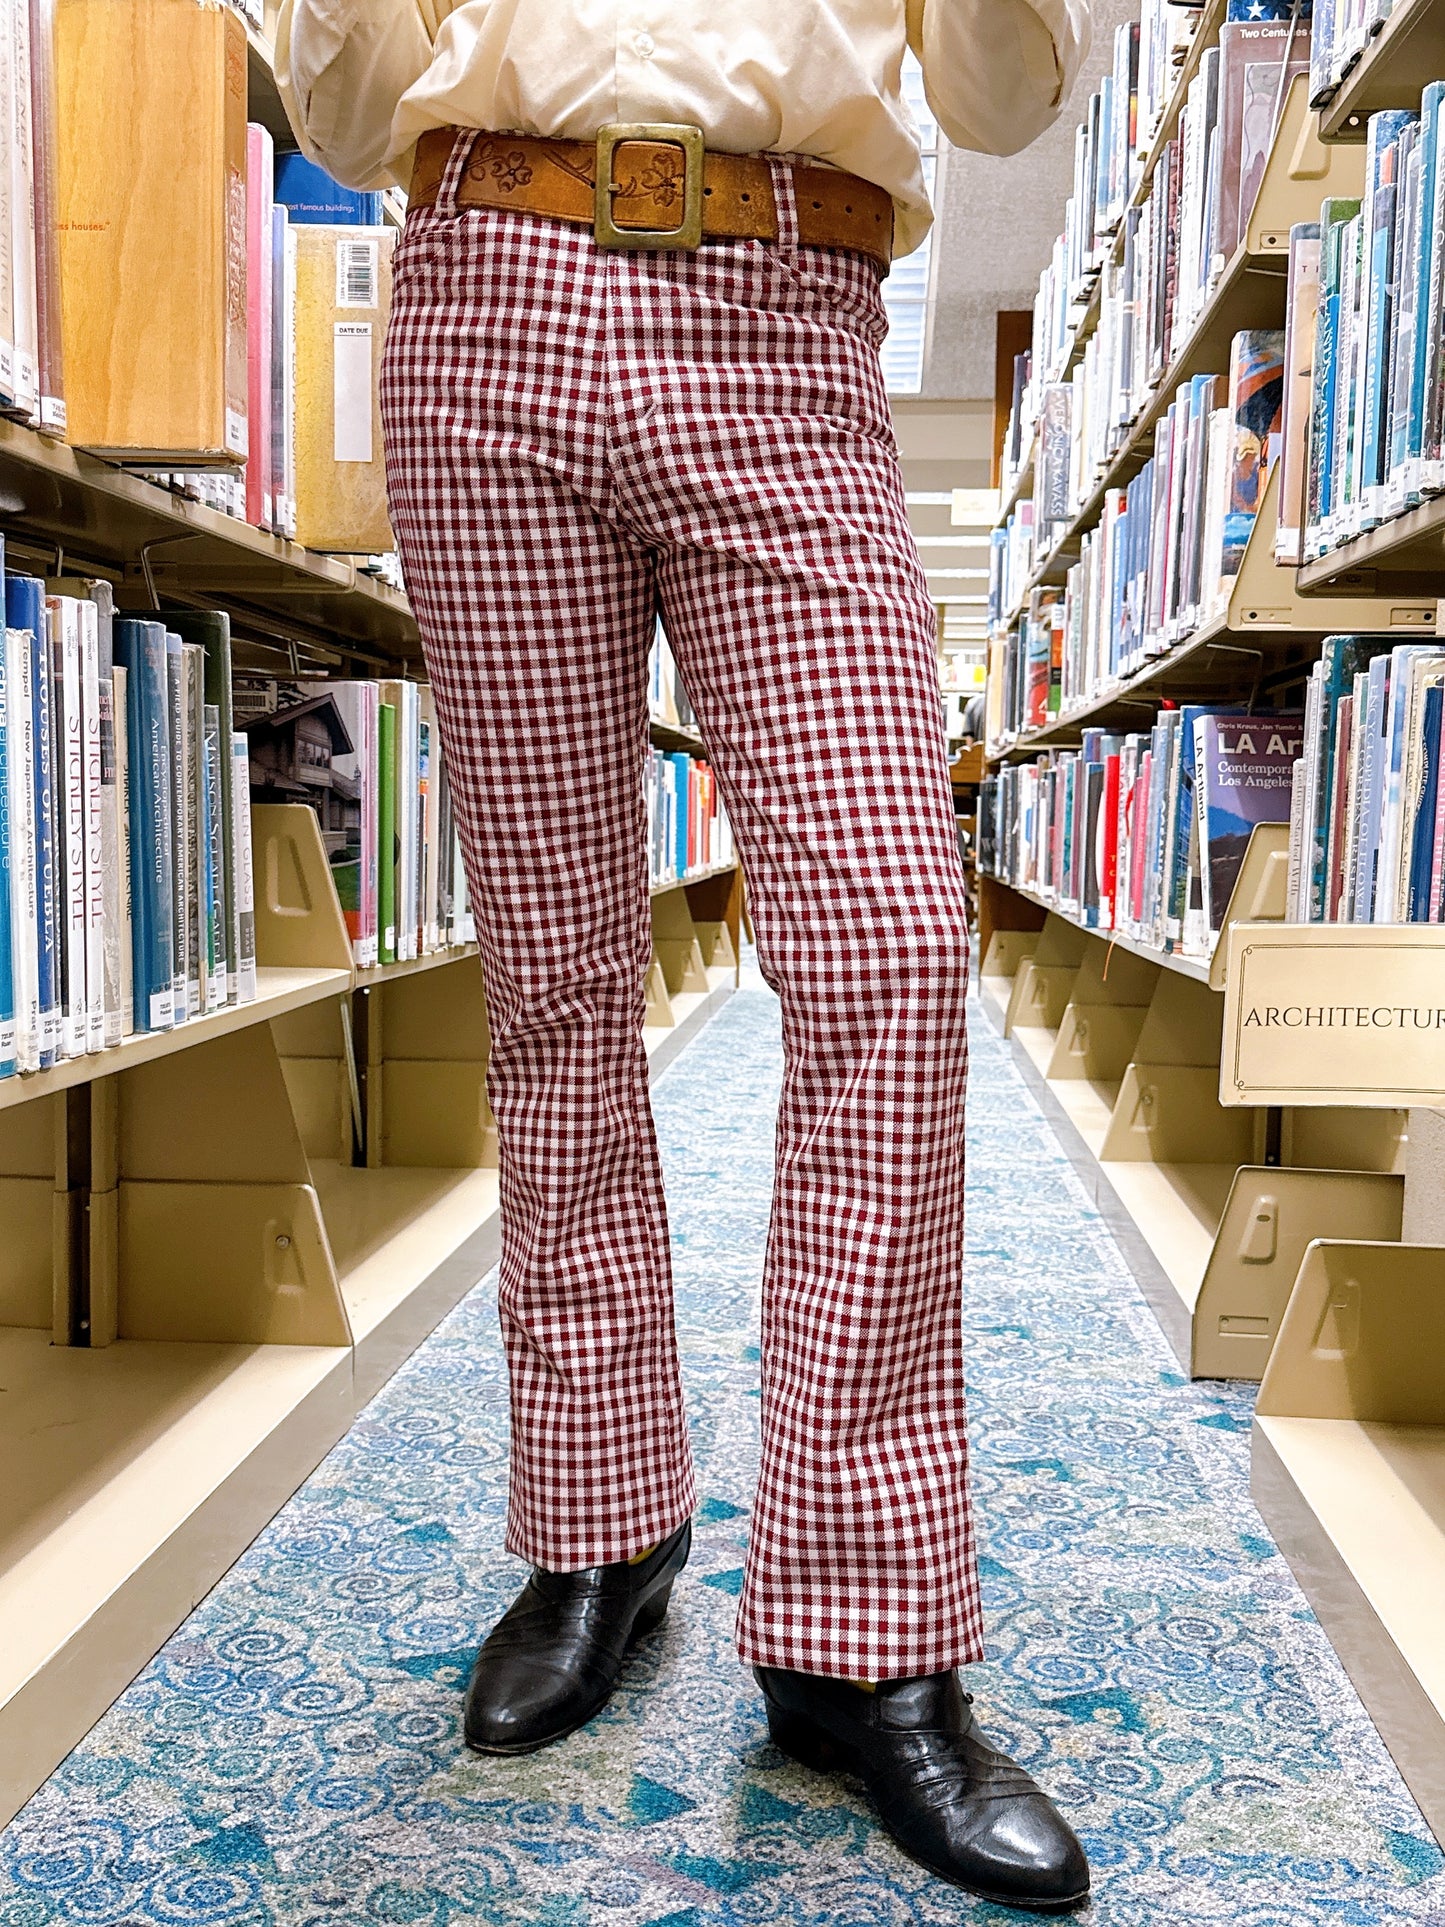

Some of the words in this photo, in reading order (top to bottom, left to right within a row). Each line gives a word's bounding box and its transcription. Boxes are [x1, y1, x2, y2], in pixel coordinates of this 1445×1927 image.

[1240, 29, 1259, 38] Two
[1261, 28, 1307, 37] Centues
[325, 204, 355, 213] buildings
[1396, 204, 1404, 235] The
[1393, 239, 1402, 276] New
[1368, 272, 1379, 358] JAPANESE
[1317, 294, 1333, 475] LANDSCAPING
[1365, 363, 1375, 446] GARDENS
[1052, 398, 1065, 465] VERONICA
[1051, 471, 1063, 516] KAVASS
[39, 651, 50, 775] HOUSES
[174, 687, 182, 715] FIELD
[151, 718, 160, 789] American
[176, 750, 183, 761] TO
[1196, 736, 1203, 758] LA
[1218, 732, 1257, 754] LA
[1266, 734, 1303, 755] Ar
[1218, 761, 1293, 775] Contempora
[1362, 683, 1379, 819] ENCYCLOPEDIA
[42, 788, 51, 824] OF
[69, 715, 82, 842] STICKLEY
[88, 717, 101, 842] STICKLEY
[161, 745, 171, 839] Encyclopedia
[176, 764, 184, 841] CONTEMPORARY
[240, 763, 249, 836] BROKEN
[1196, 763, 1206, 821] Artland
[1218, 774, 1241, 785] Los
[1245, 776, 1293, 789] Angeles
[1355, 749, 1366, 824] GARDEN
[153, 793, 163, 884] Architecture
[1294, 818, 1302, 861] Started
[1348, 835, 1359, 898] IRISES
[1434, 834, 1444, 865] THE
[26, 830, 34, 920] Architecture
[71, 848, 84, 930] STYLE
[91, 848, 102, 928] STYLE
[243, 847, 251, 905] GLASS
[1291, 866, 1300, 896] With
[177, 894, 185, 961] ARCHITECTURE
[1243, 1007, 1445, 1028] ARCHITECTUR
